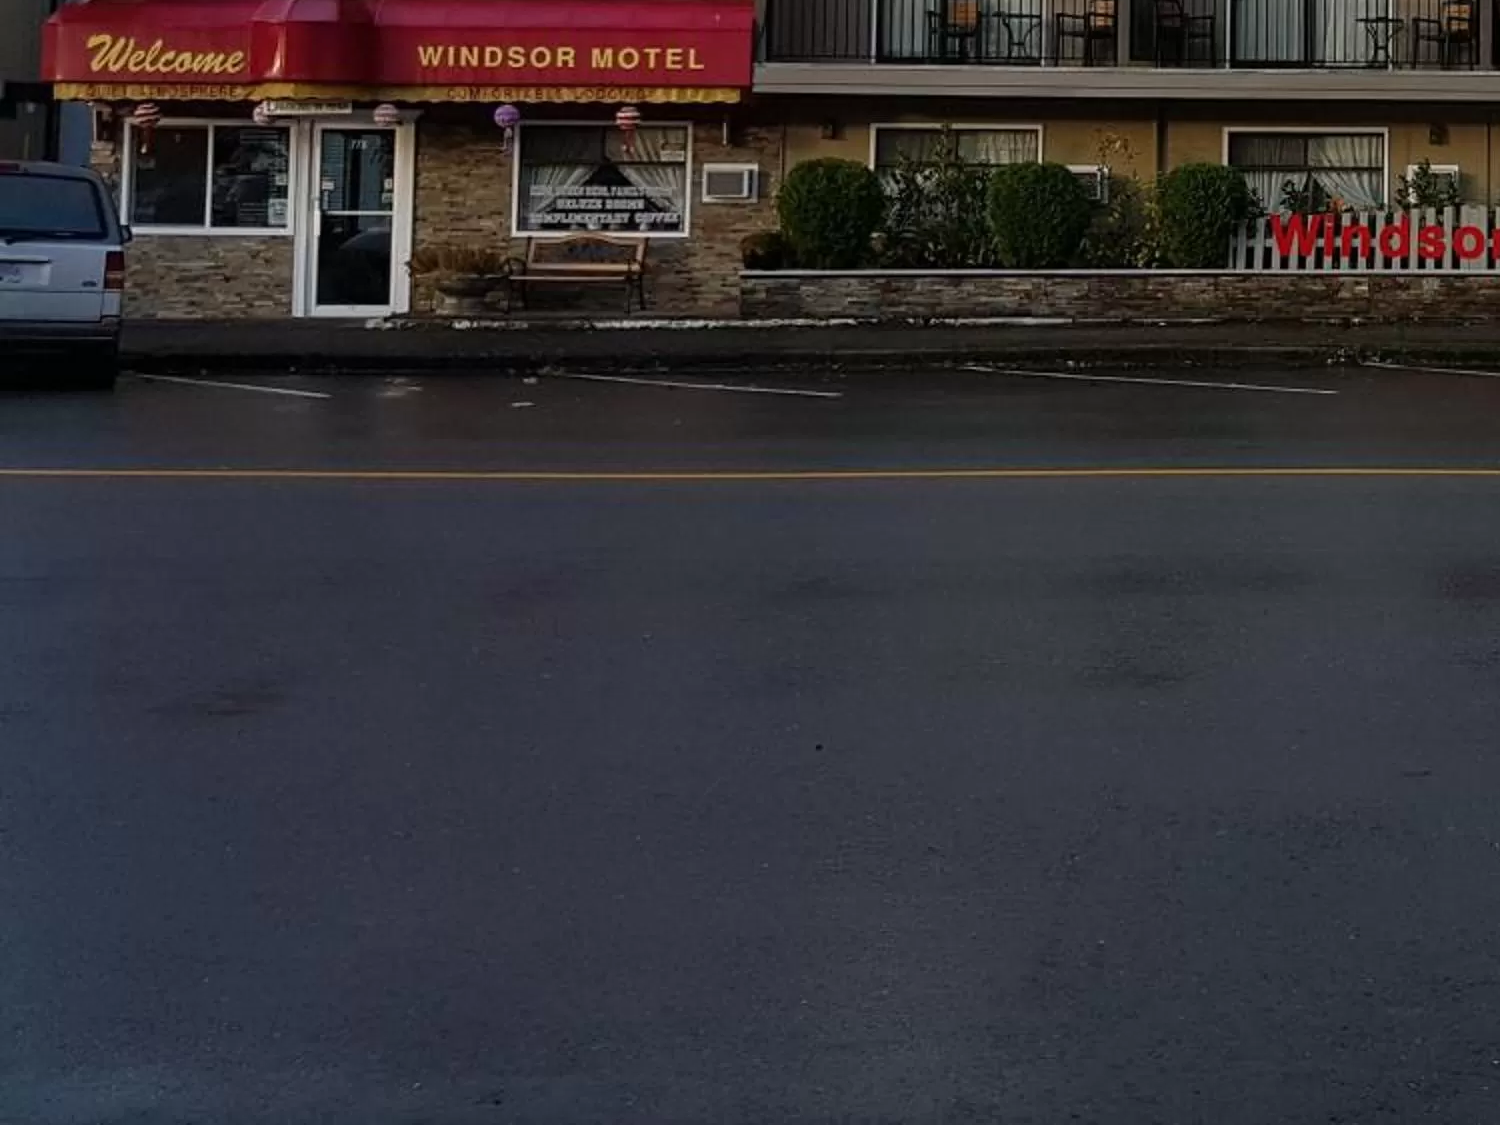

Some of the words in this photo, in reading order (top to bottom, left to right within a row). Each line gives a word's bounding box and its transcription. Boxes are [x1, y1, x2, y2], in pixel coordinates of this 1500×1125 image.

[87, 34, 245, 73] Welcome
[417, 46, 576, 68] WINDSOR
[591, 47, 705, 69] MOTEL
